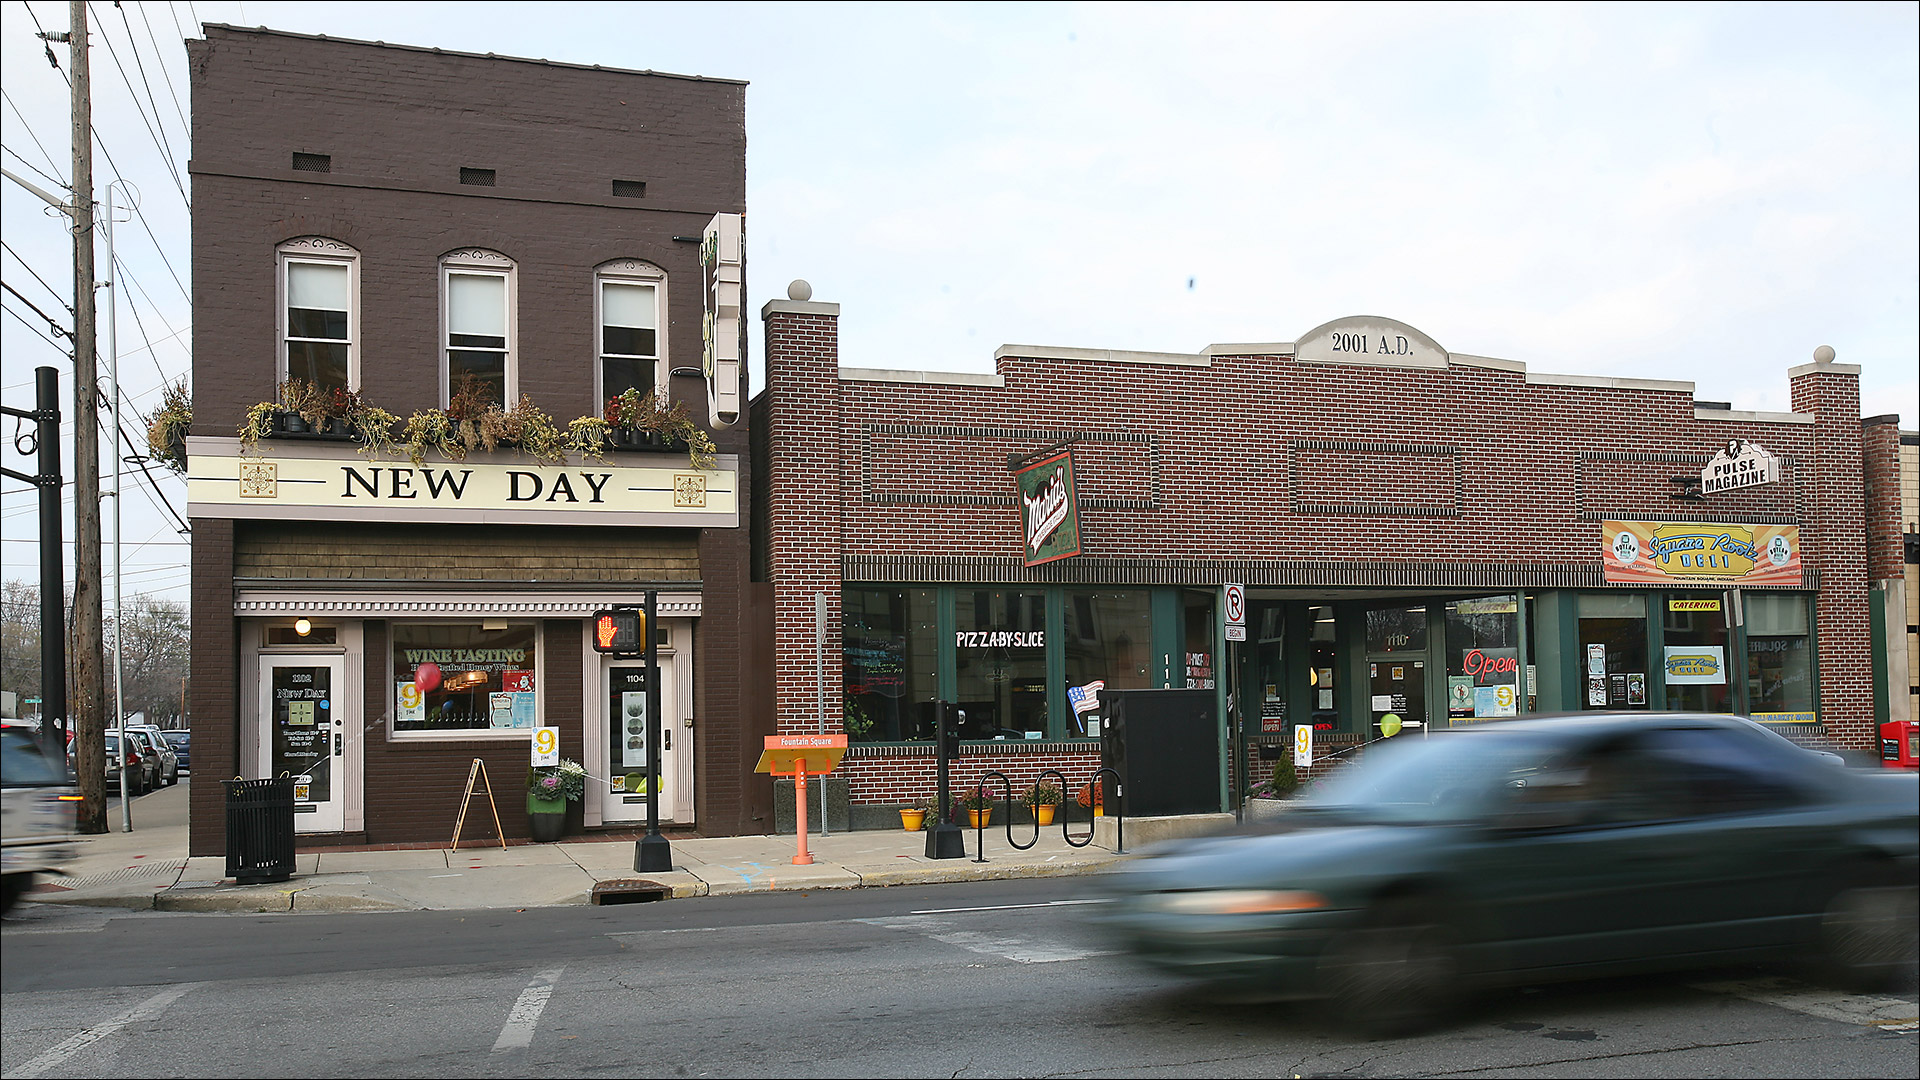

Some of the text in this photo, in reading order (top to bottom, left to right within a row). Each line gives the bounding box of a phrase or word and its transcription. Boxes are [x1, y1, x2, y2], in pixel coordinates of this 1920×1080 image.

[1332, 332, 1414, 356] 2001 A.D.
[1714, 459, 1756, 477] PULSE
[341, 466, 613, 504] NEW DAY
[1704, 470, 1766, 493] MAGAZINE
[1648, 532, 1759, 564] Square Rootz
[1672, 601, 1717, 609] CATERING
[404, 648, 526, 663] WINE TASTING
[1463, 648, 1517, 684] Open
[292, 674, 312, 683] 1102
[466, 663, 493, 672] Honey
[493, 663, 520, 672] Wines
[626, 674, 645, 683] 1104
[401, 683, 422, 709] 9
[1496, 686, 1514, 708] 9
[1314, 723, 1333, 731] OPEN
[535, 729, 556, 755] 9
[780, 737, 832, 747] Fountain Square
[1297, 727, 1309, 754] 9
